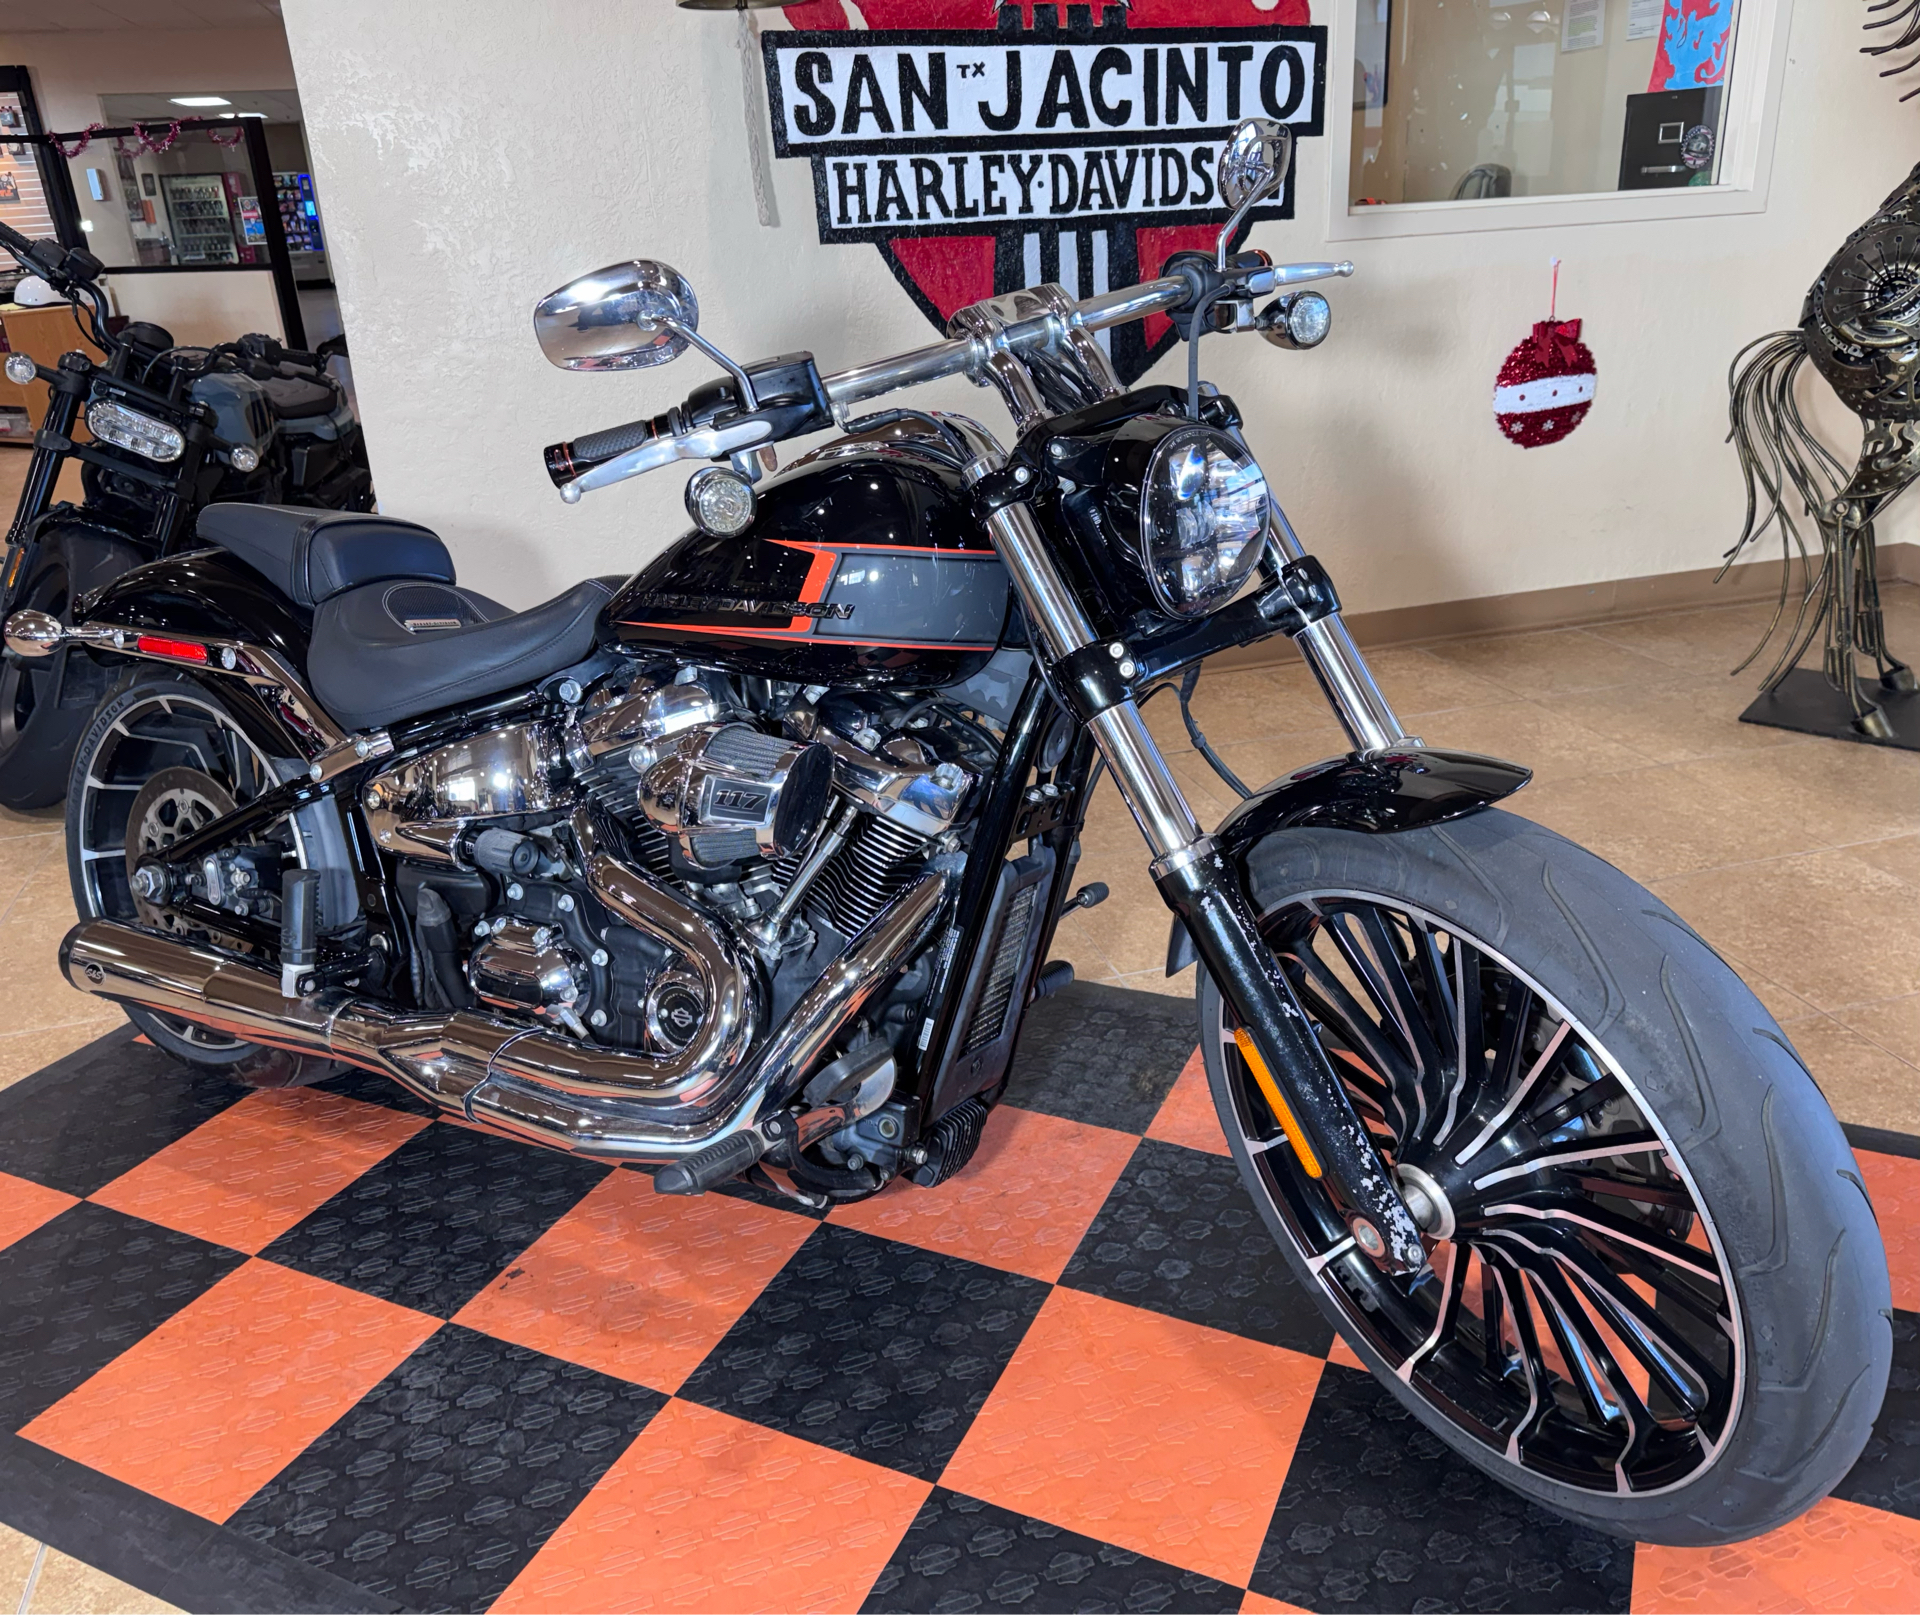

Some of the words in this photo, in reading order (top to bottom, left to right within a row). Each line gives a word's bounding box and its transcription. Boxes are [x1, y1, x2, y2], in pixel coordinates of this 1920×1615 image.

[793, 51, 949, 137] SAN
[956, 61, 986, 80] TX
[978, 45, 1306, 132] JACINTO
[832, 147, 1280, 226] HARLEY·DAVIDS
[713, 789, 768, 810] 117
